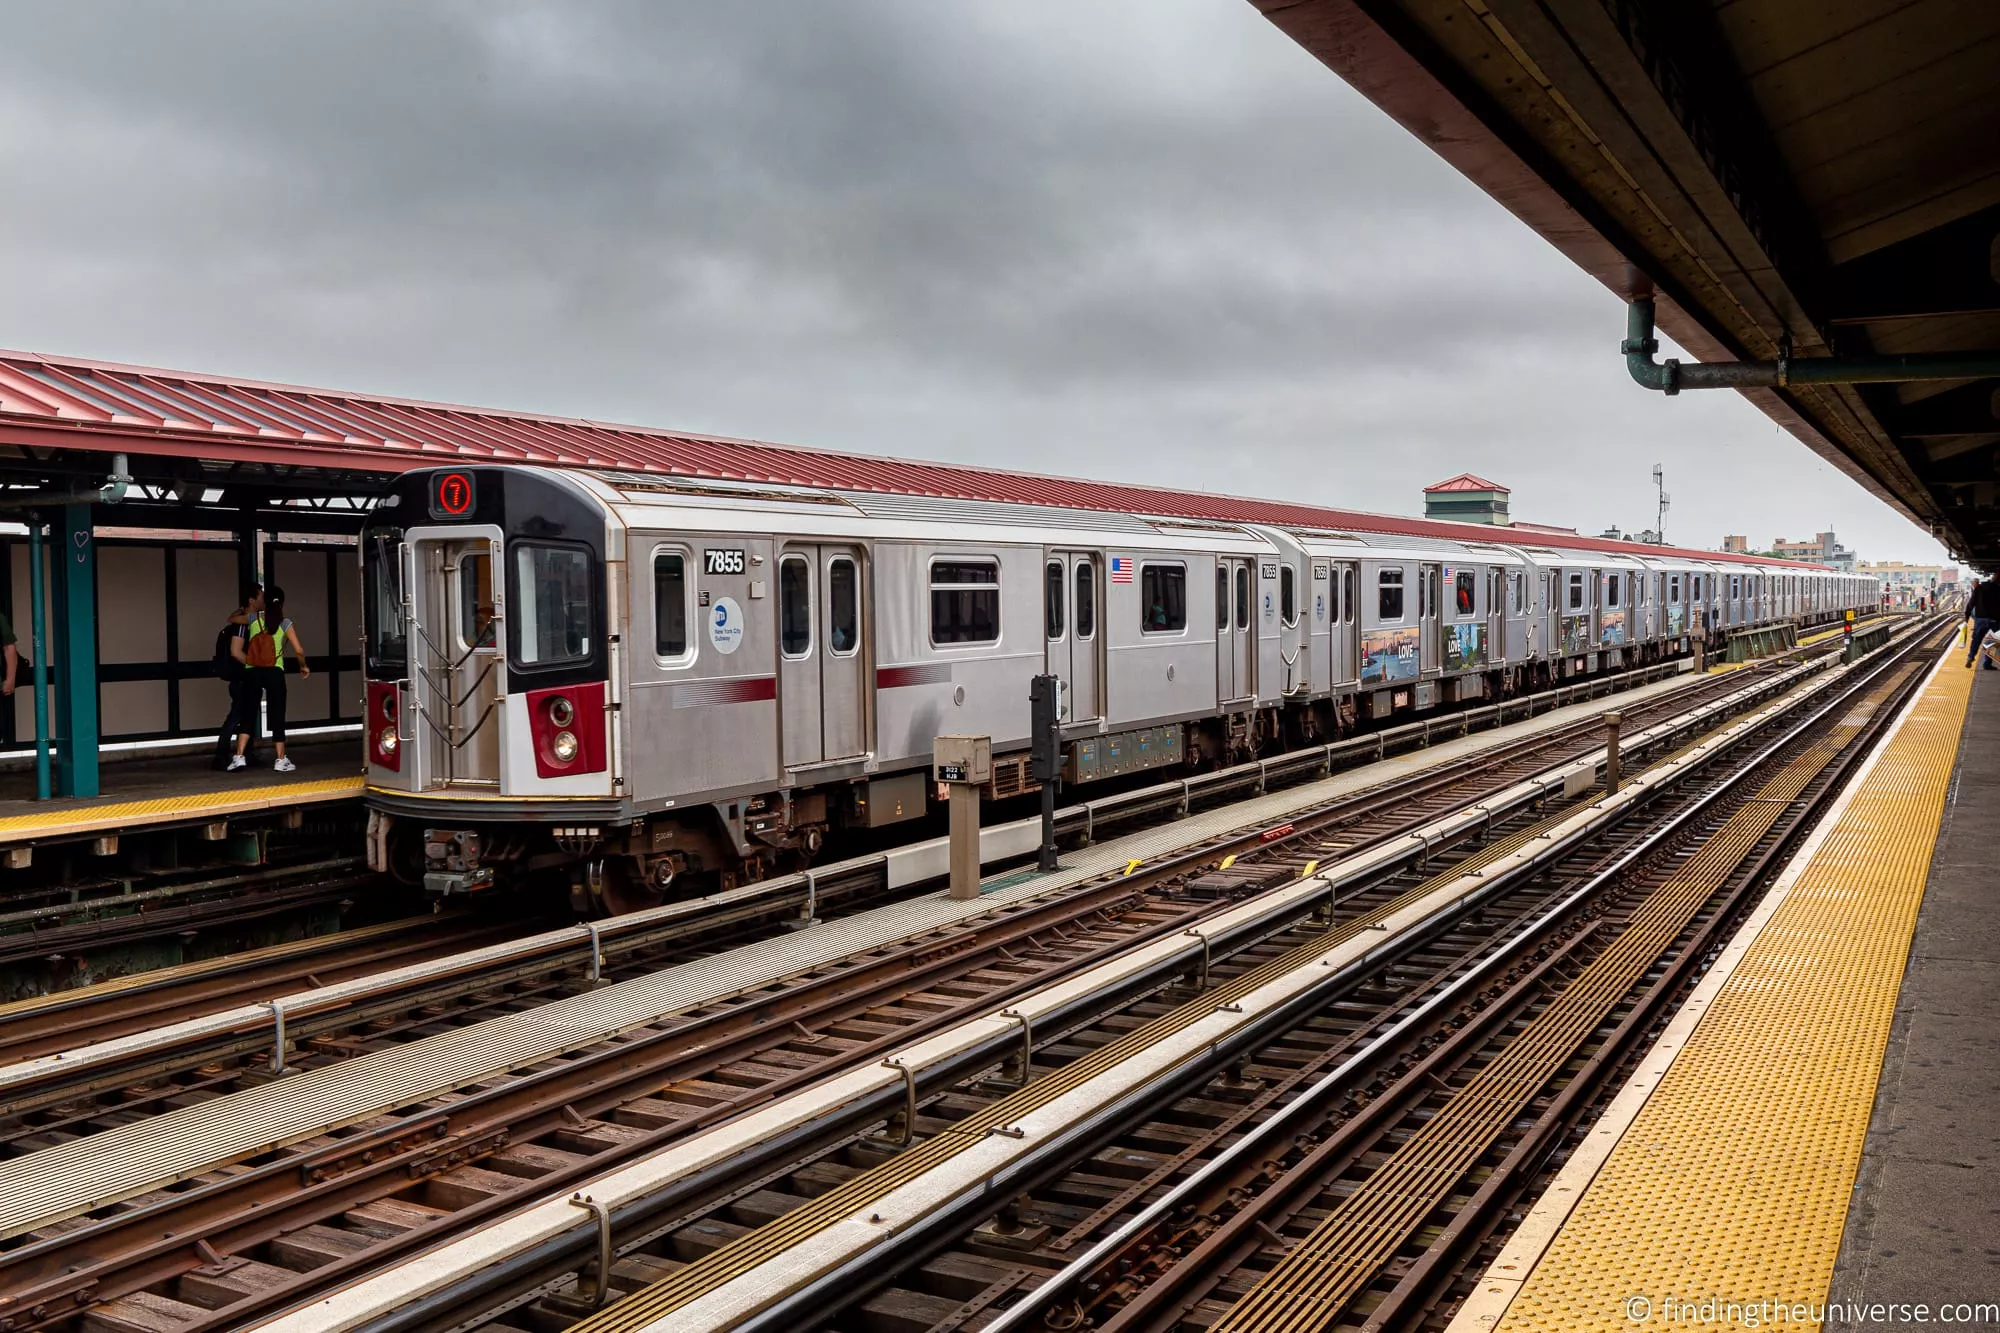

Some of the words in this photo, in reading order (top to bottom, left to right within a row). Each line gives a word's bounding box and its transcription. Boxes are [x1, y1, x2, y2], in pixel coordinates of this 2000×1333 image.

[449, 483, 461, 506] 7
[706, 551, 743, 572] 7855
[1263, 565, 1276, 578] 7855
[1315, 566, 1327, 579] 7856
[1398, 644, 1413, 659] LOVE
[1448, 639, 1461, 653] LOVE
